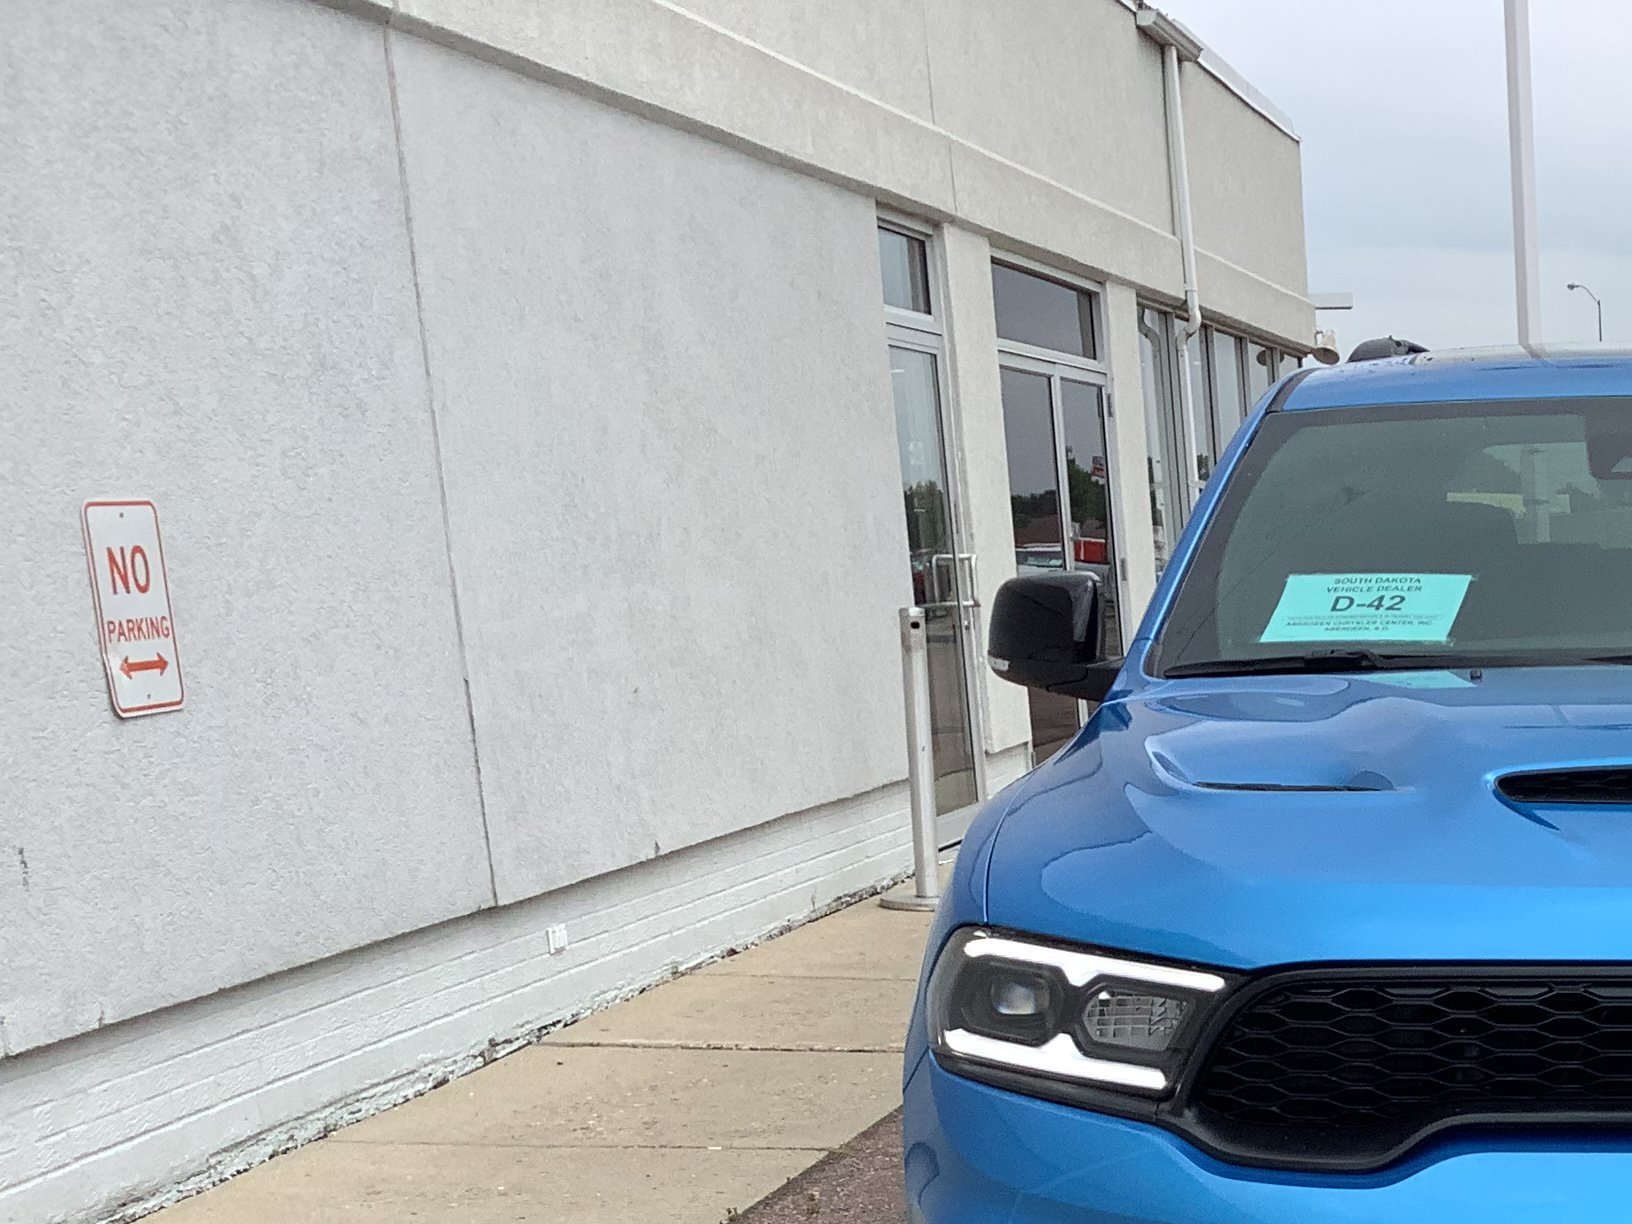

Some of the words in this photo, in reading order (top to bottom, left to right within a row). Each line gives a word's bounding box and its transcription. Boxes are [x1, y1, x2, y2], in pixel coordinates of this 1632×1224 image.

[106, 544, 150, 595] NO
[1333, 577, 1372, 585] SOUTH
[1375, 576, 1421, 584] DAKOTA
[1330, 594, 1406, 612] D-42
[106, 615, 170, 644] PARKING
